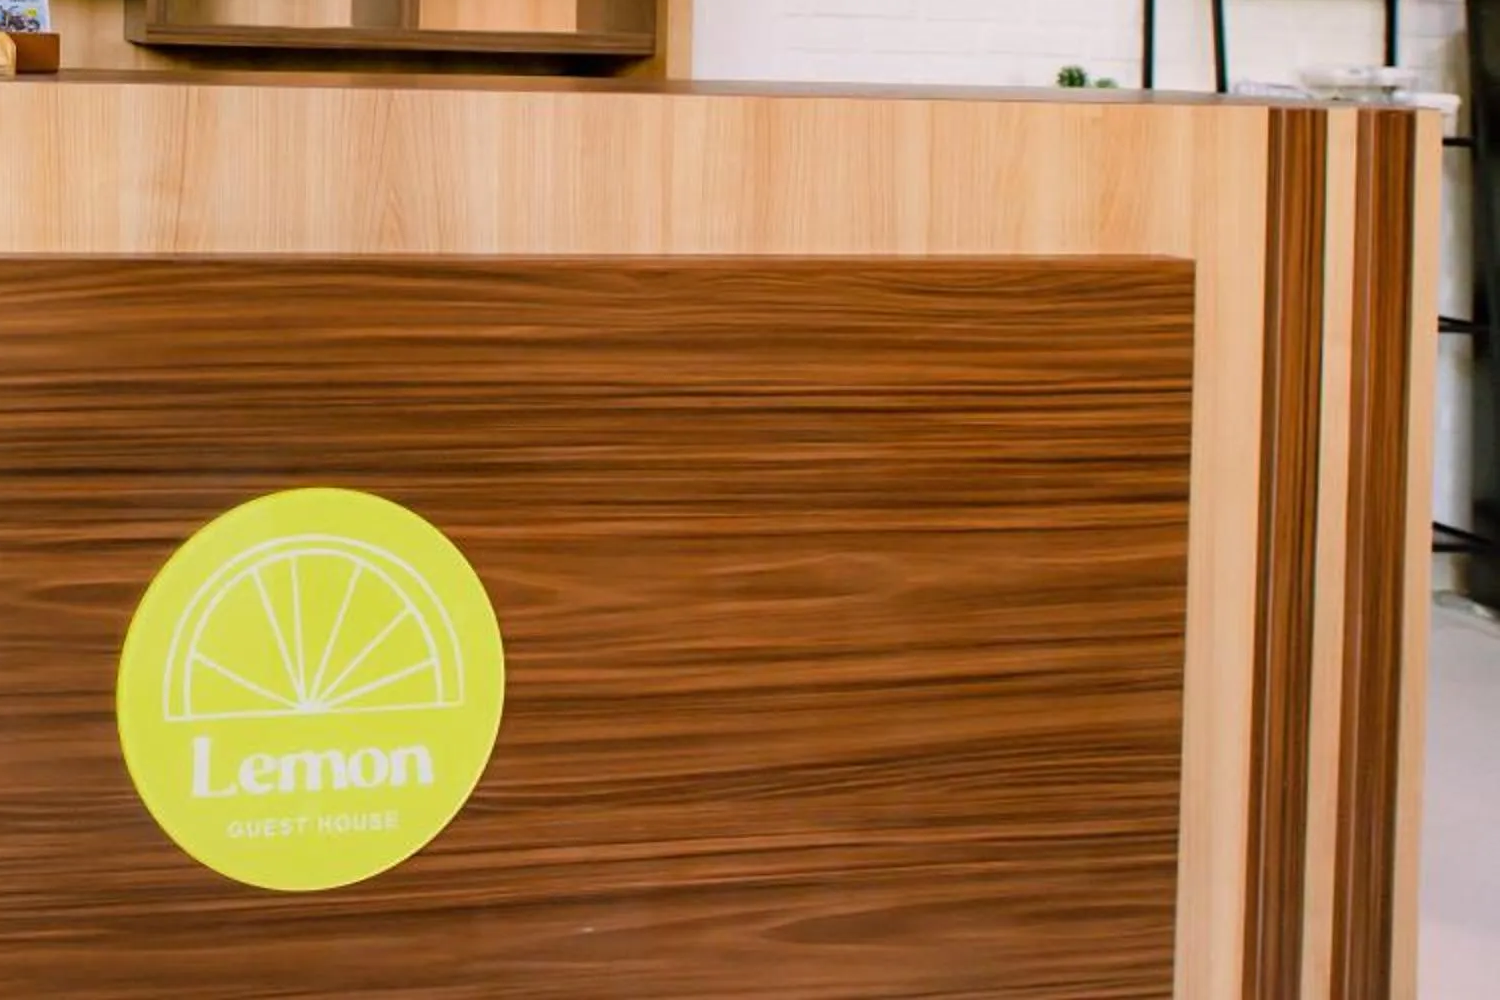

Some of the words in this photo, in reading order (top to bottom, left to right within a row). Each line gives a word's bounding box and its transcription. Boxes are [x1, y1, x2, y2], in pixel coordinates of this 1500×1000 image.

[190, 734, 435, 799] Lemon
[226, 815, 309, 840] GUEST
[317, 808, 400, 834] HOUSE
